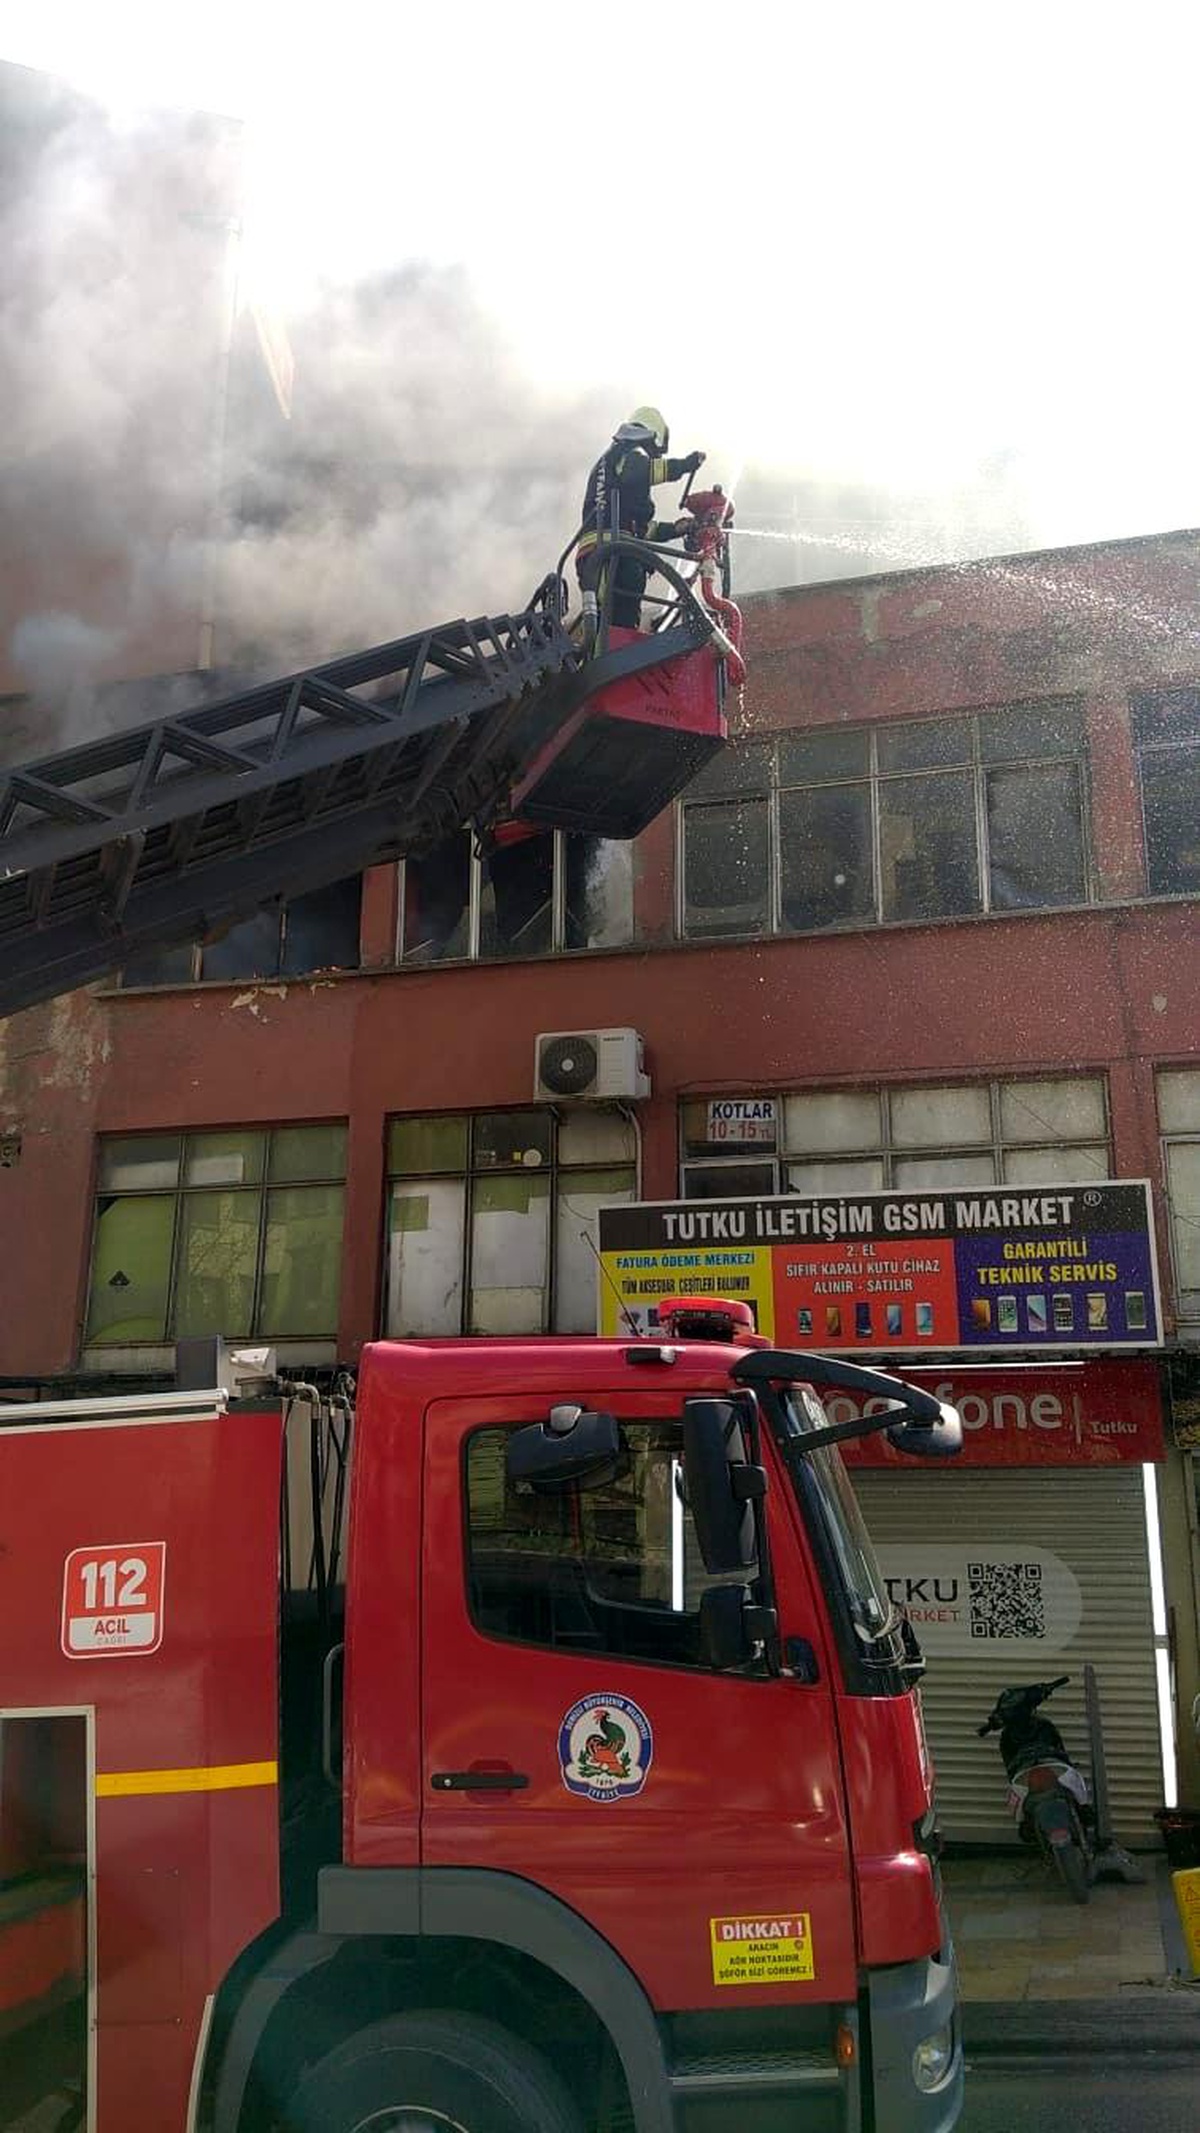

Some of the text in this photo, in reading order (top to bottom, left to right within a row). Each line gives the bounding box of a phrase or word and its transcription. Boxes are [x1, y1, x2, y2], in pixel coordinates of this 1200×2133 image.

[711, 1102, 772, 1119] KOTLAR
[710, 1120, 727, 1139] 10
[738, 1120, 757, 1139] 15
[662, 1210, 746, 1240] TUTKU
[755, 1200, 873, 1242] İLETİŞİM
[883, 1202, 946, 1231] GSM
[955, 1195, 1075, 1229] MARKET
[862, 1244, 877, 1257] EL
[1003, 1236, 1087, 1260] GARANTİLİ
[616, 1256, 658, 1268] FATURA
[786, 1263, 818, 1277] SIFIR
[821, 1261, 863, 1275] KAPALI
[867, 1260, 899, 1274] KUTU
[977, 1260, 1118, 1285] TEKNİK SERVİS
[813, 1281, 854, 1294] ALINIR
[866, 1279, 914, 1293] SATILIR
[1089, 1421, 1138, 1434] Tutku
[81, 1557, 148, 1609] 112
[884, 1578, 958, 1602] TKU
[721, 1920, 792, 1940] DİKKAT
